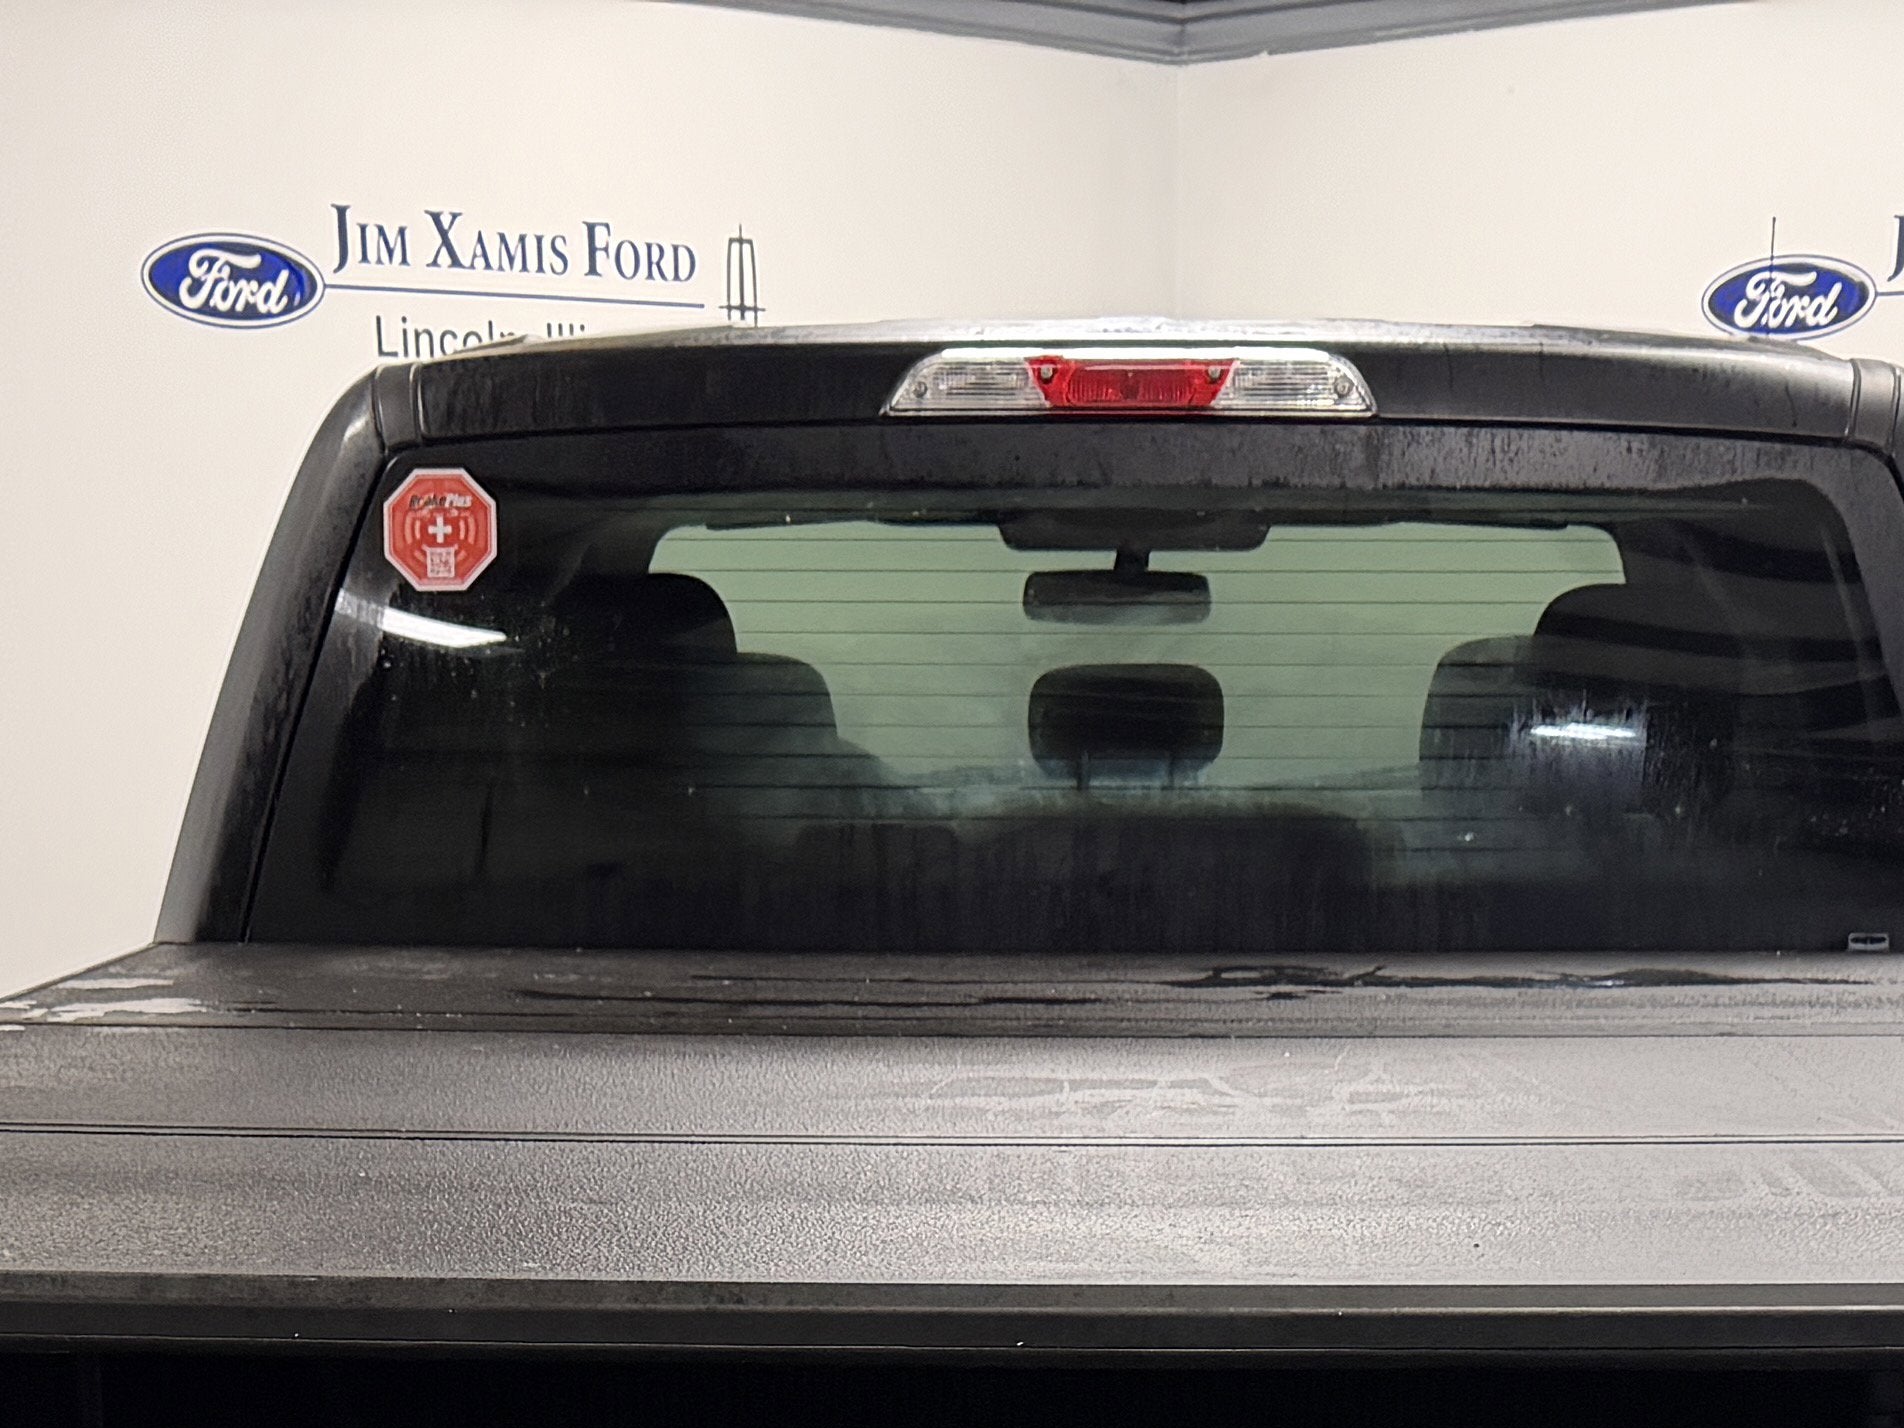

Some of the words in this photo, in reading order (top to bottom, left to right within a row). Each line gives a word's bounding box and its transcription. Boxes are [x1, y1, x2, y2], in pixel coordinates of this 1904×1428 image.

[329, 202, 412, 274] JIM
[424, 208, 570, 277] XAMIS
[582, 219, 697, 283] FORD
[178, 247, 291, 315] Ford
[1733, 269, 1844, 329] Ford
[374, 314, 514, 359] Lincol
